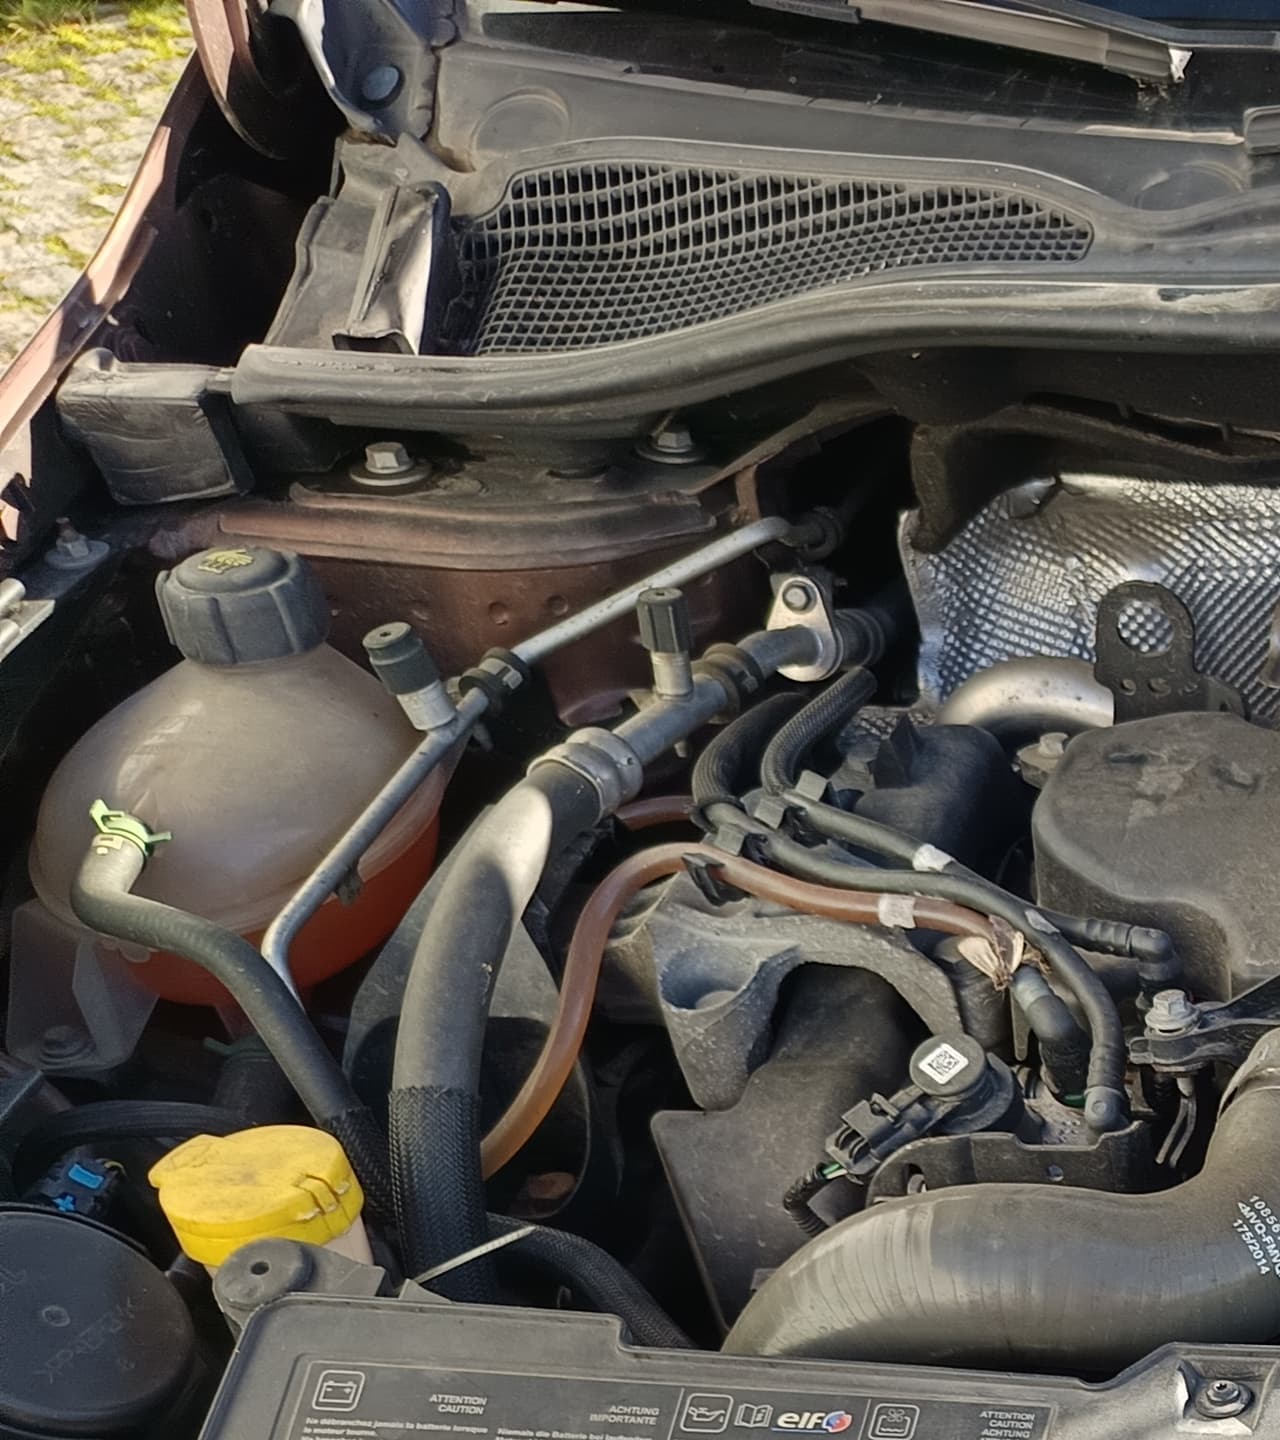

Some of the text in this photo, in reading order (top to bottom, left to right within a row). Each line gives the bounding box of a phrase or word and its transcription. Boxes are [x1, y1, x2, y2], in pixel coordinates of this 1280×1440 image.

[1232, 1218, 1270, 1275] 175/2014
[429, 1394, 487, 1405] ATTENTION
[437, 1404, 484, 1414] CAUTION
[609, 1405, 660, 1415] ACHTUNG
[589, 1413, 657, 1424] IMPORTANTE
[776, 1410, 825, 1429] elf
[980, 1410, 1035, 1420] ATTENTION
[989, 1420, 1033, 1429] CAUTION
[981, 1428, 1030, 1438] ACHTUNG
